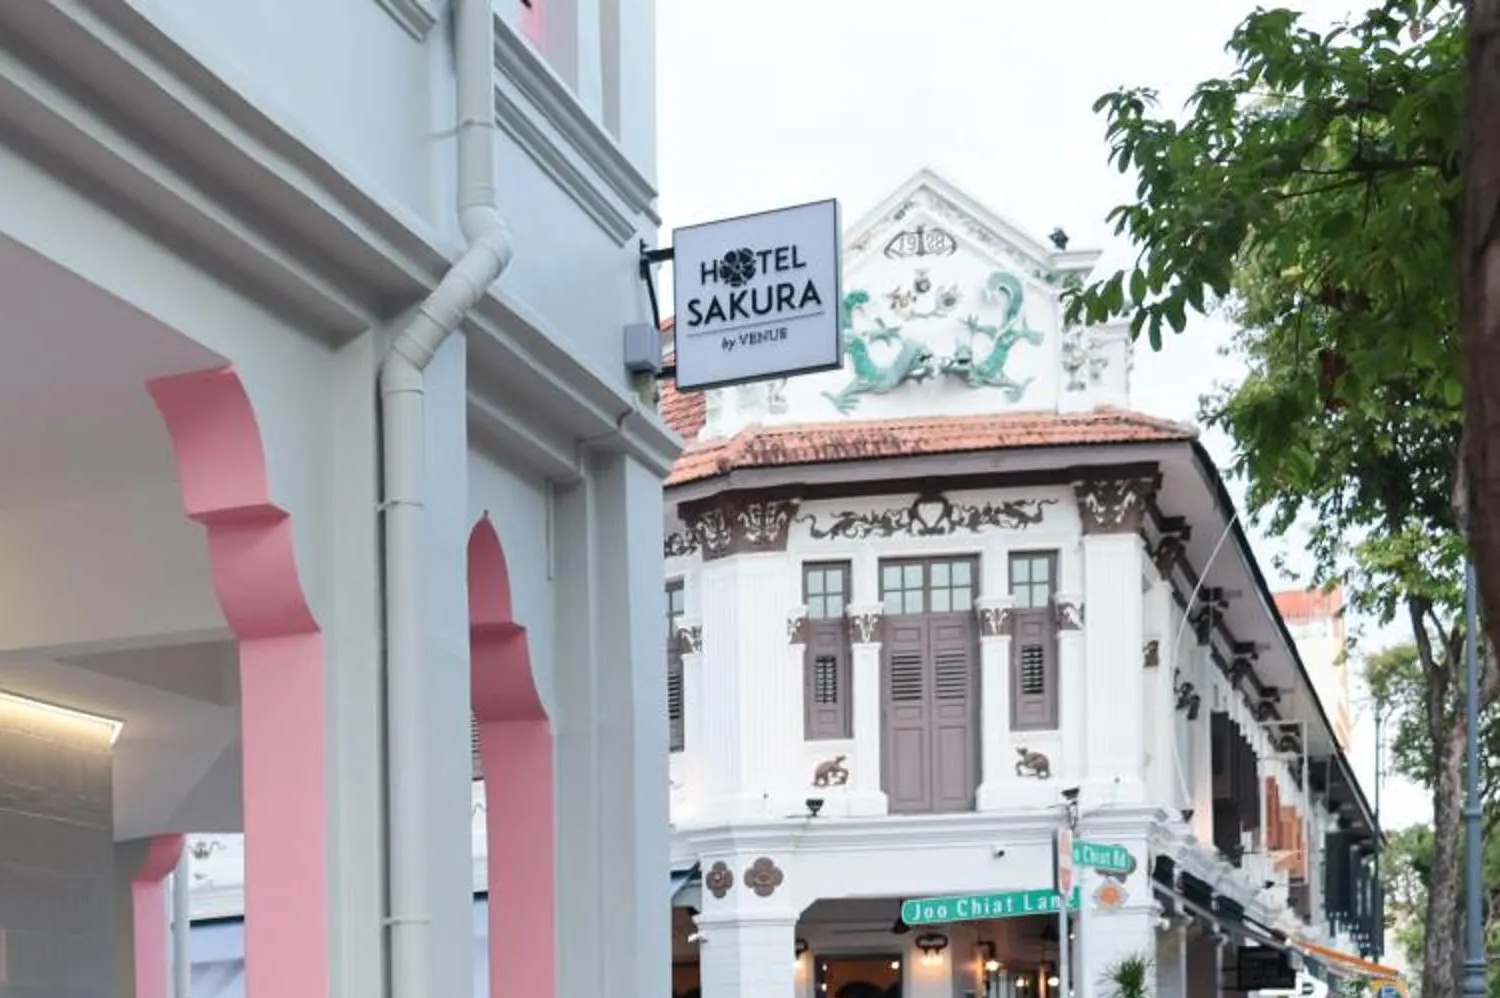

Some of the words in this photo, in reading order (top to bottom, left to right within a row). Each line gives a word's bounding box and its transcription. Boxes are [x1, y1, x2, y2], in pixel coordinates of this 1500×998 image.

[687, 279, 822, 326] SAKURA
[721, 335, 737, 350] by
[739, 327, 788, 346] VENUE
[912, 903, 948, 920] Joo
[956, 895, 1013, 915] Chiat
